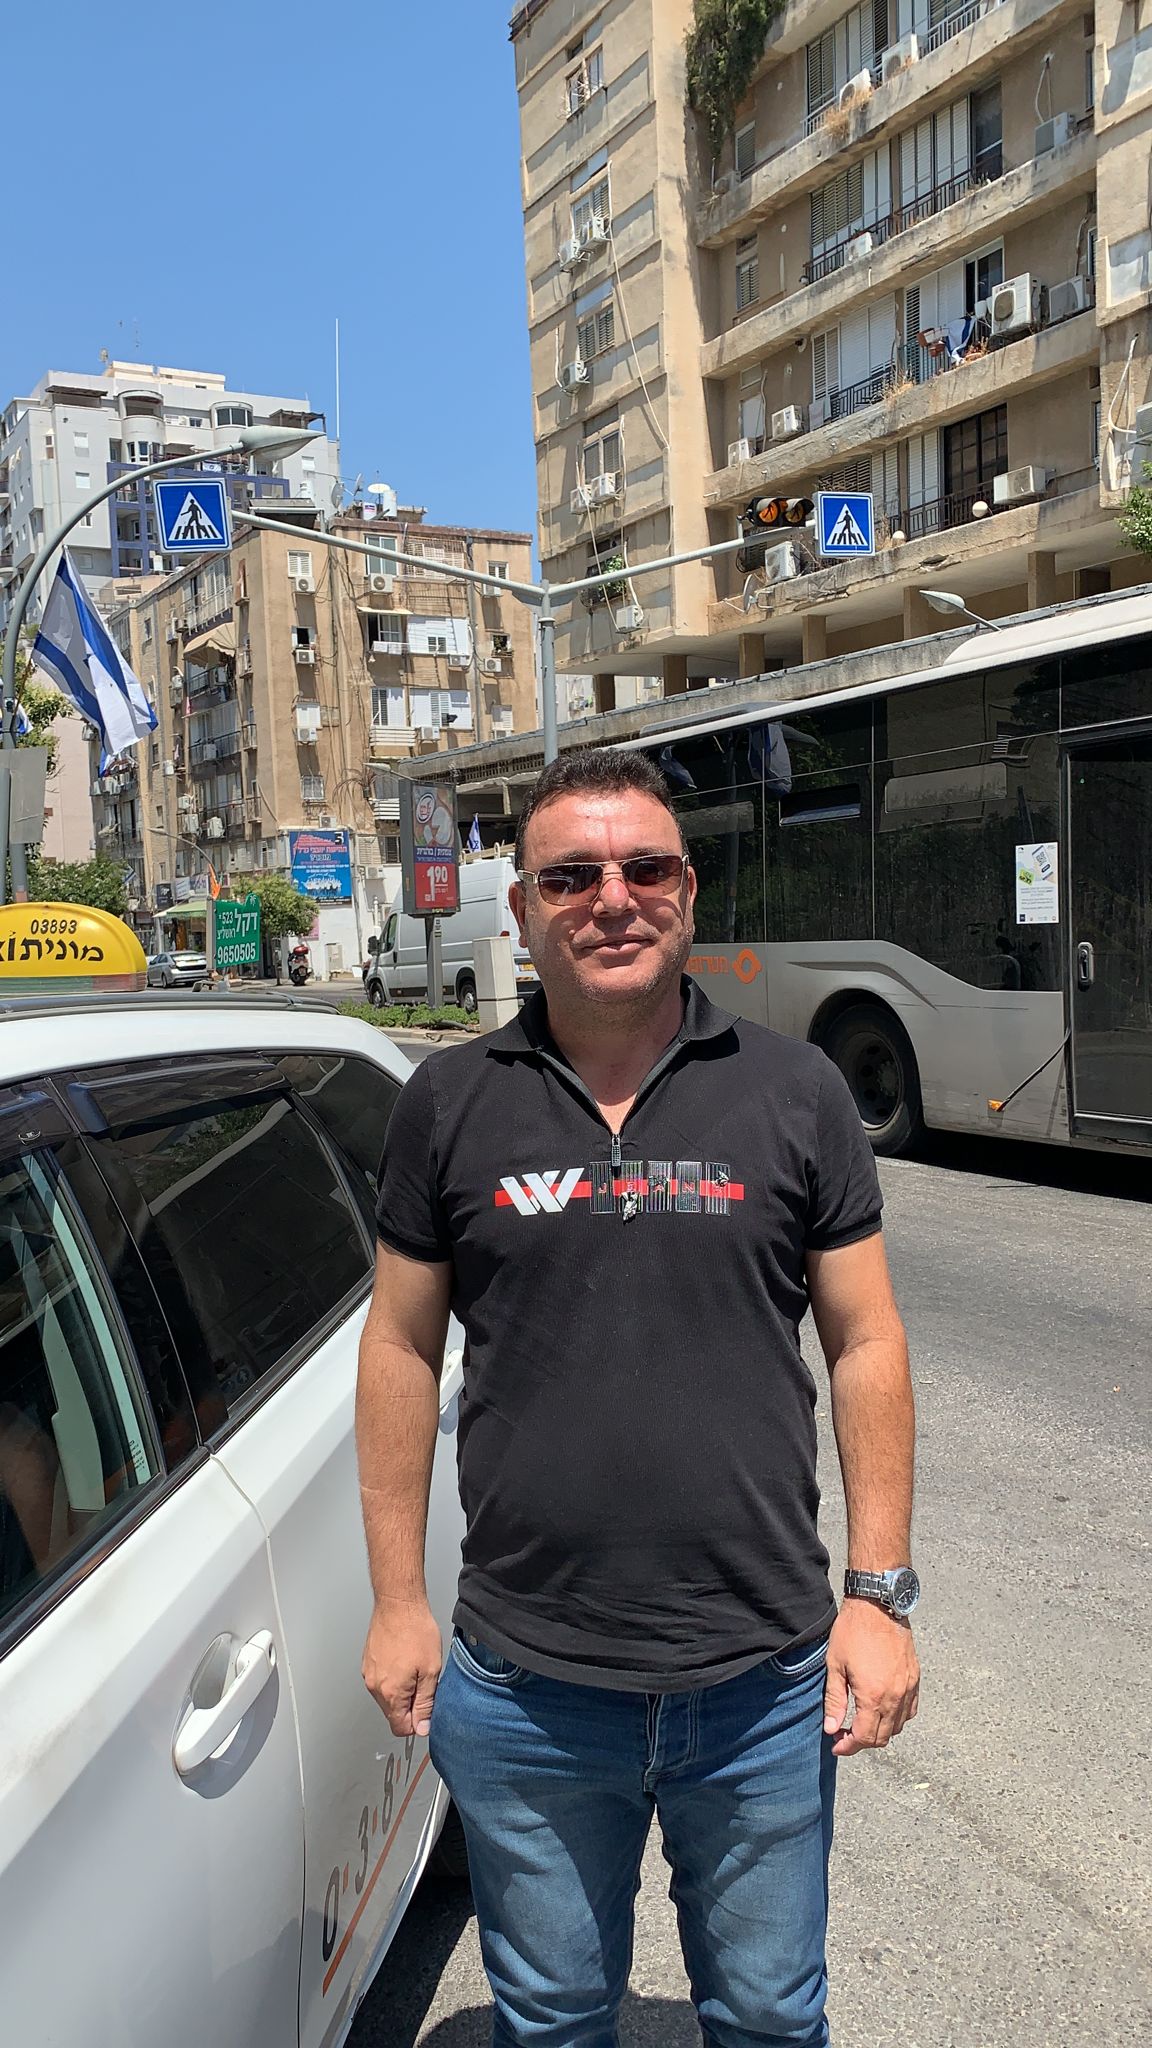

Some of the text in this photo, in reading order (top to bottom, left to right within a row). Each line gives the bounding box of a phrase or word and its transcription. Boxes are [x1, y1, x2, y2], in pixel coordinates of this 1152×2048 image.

[31, 919, 77, 934] 03893
[234, 908, 258, 937] דקל
[20, 937, 104, 961] מונית
[217, 942, 256, 965] 9650505
